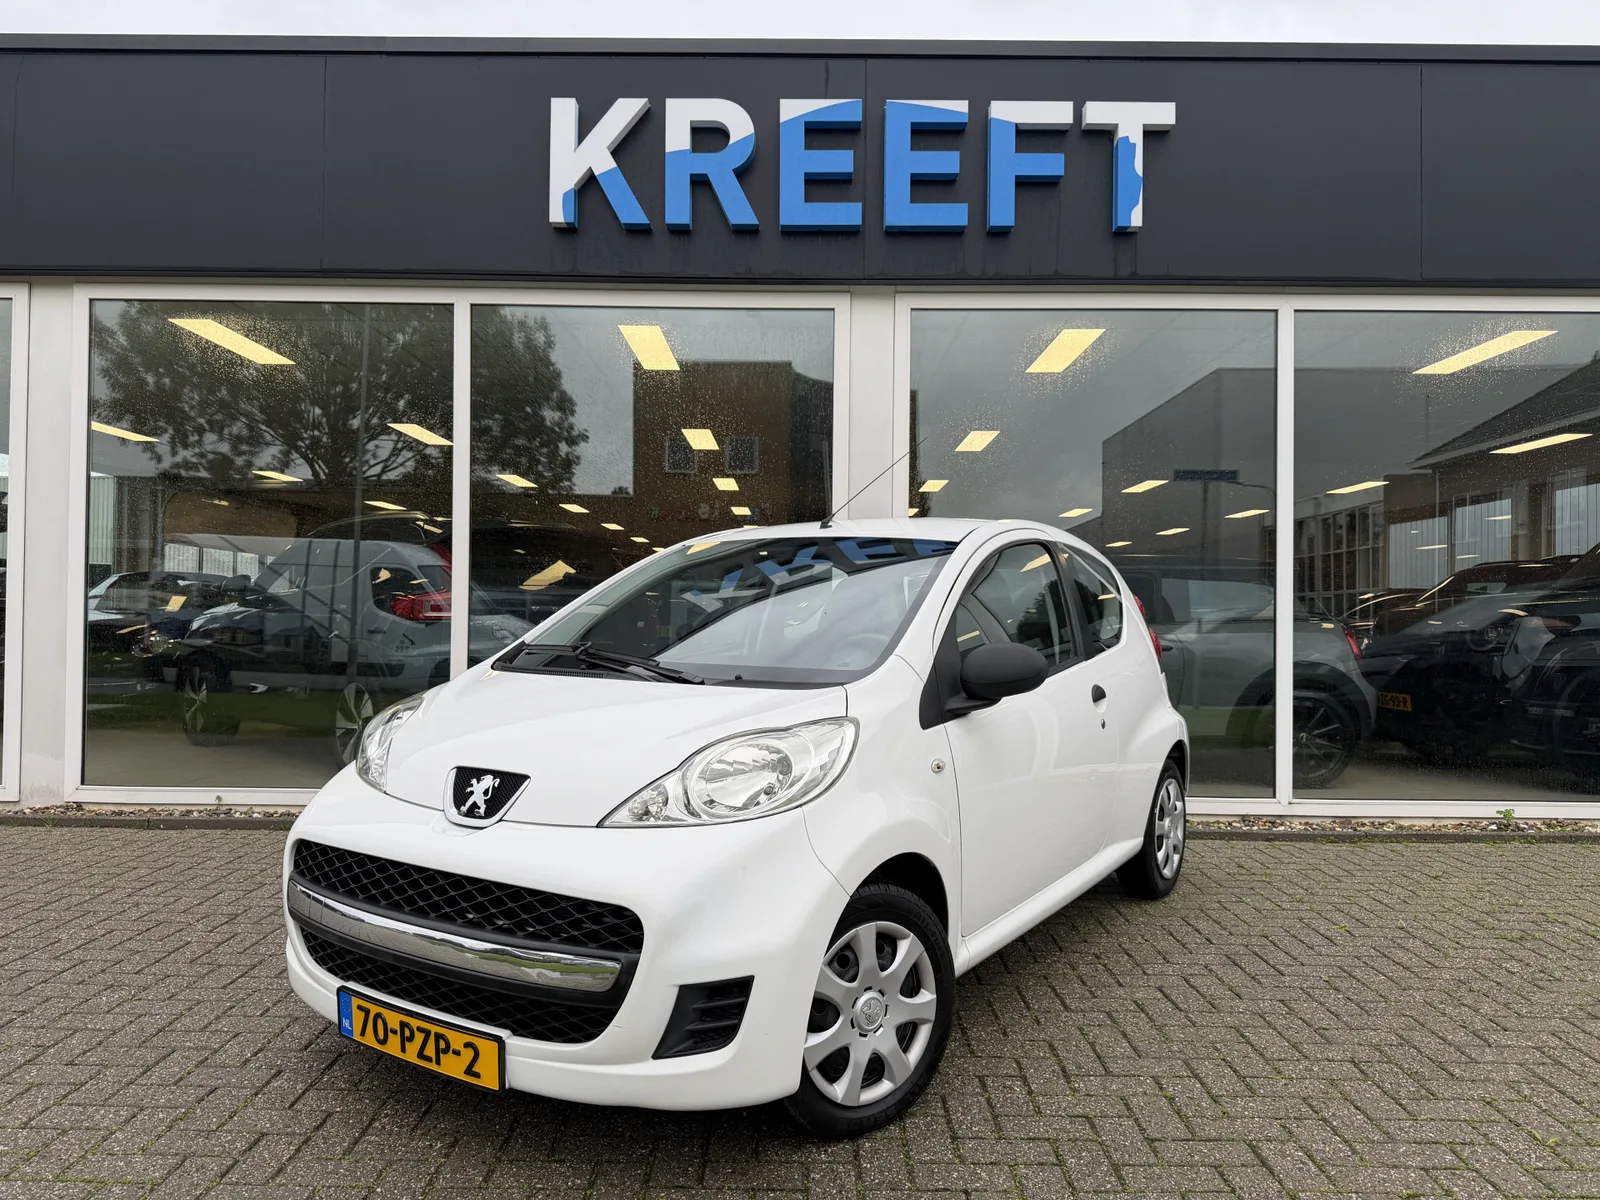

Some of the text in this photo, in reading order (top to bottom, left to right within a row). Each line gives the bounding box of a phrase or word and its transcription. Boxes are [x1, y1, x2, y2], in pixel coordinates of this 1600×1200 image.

[549, 97, 1176, 232] KREEFT
[342, 1017, 352, 1030] NL
[356, 1004, 481, 1079] 70-PZP-2
